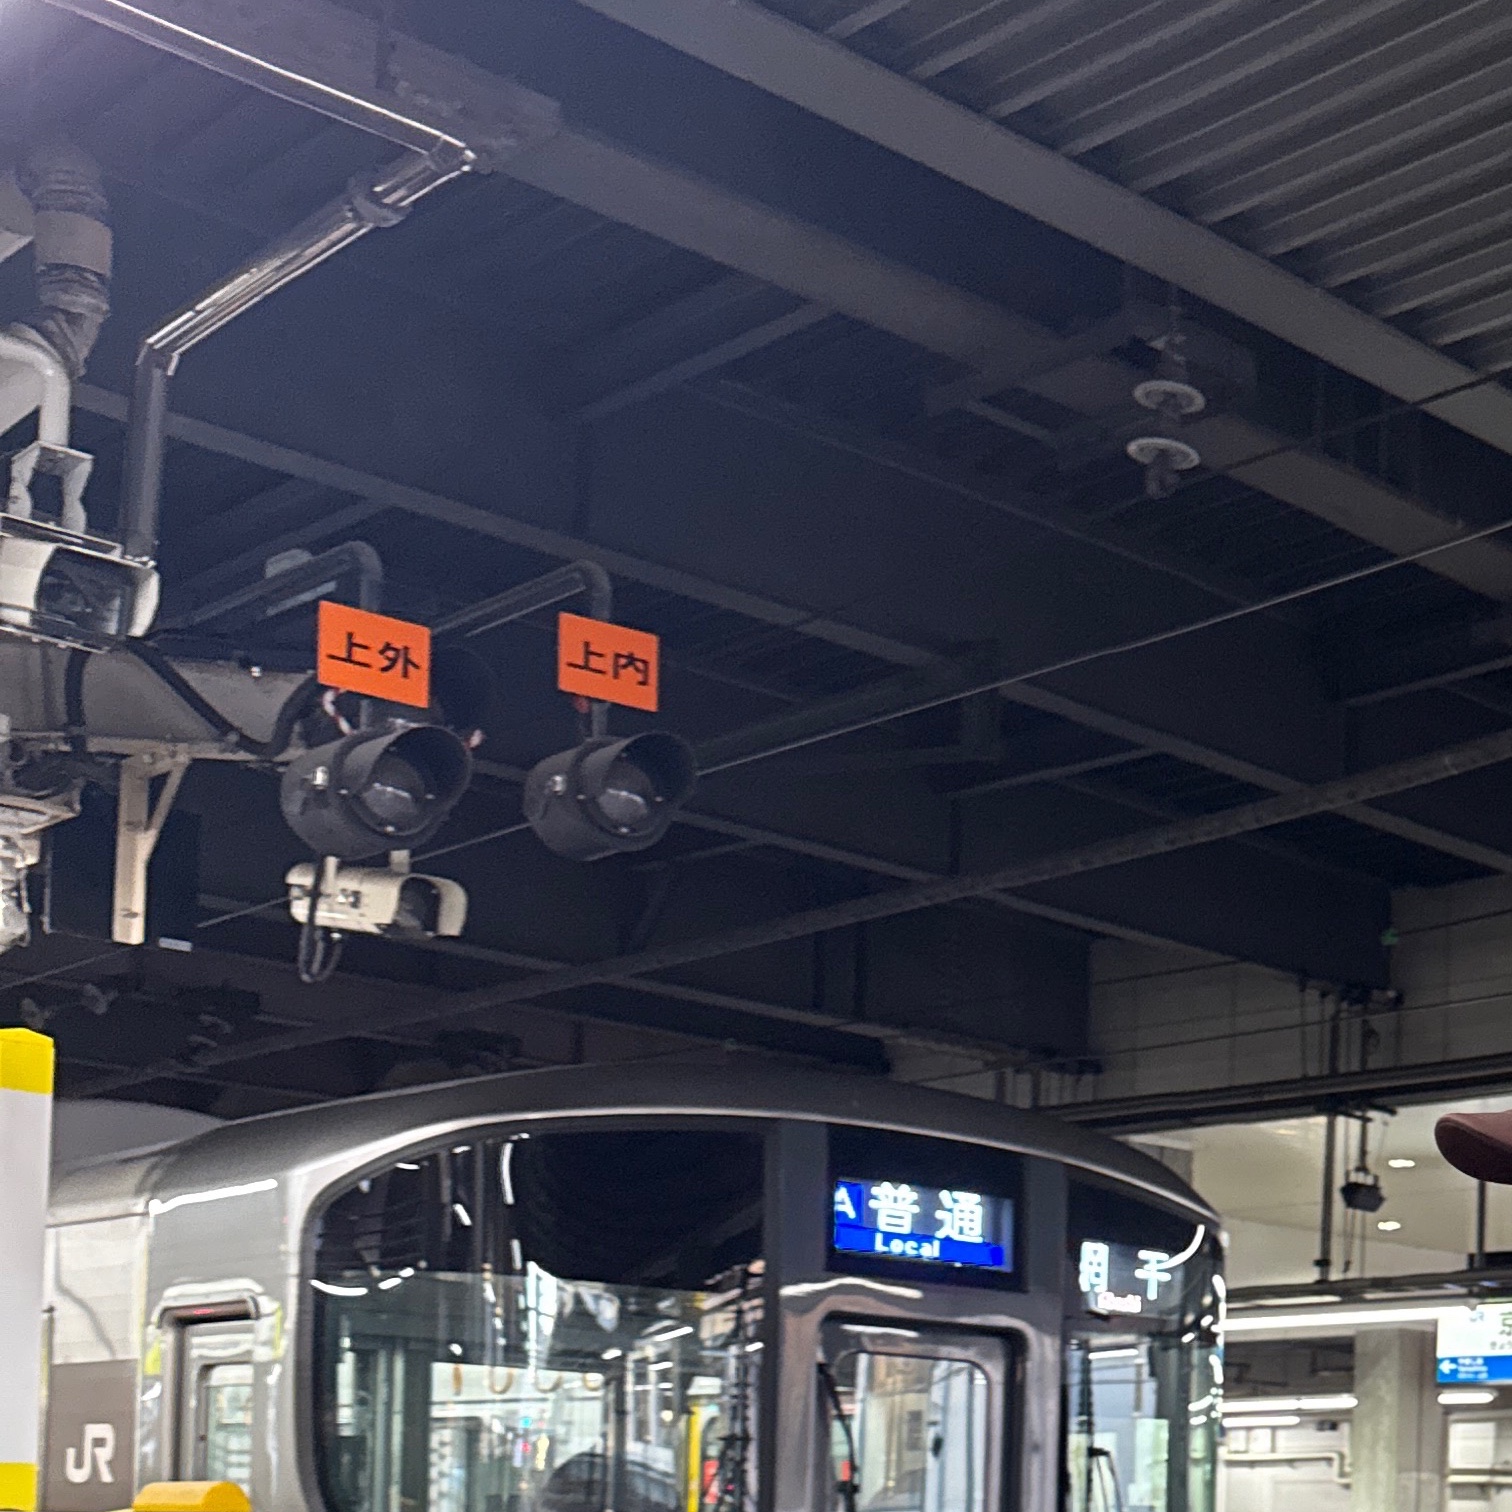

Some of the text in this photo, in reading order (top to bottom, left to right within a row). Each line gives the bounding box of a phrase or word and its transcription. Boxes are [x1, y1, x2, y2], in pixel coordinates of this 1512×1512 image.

[326, 632, 421, 680] 上外
[566, 641, 651, 687] 上内
[868, 1181, 984, 1244] 普通
[874, 1232, 941, 1258] Local
[65, 1423, 116, 1484] JR
